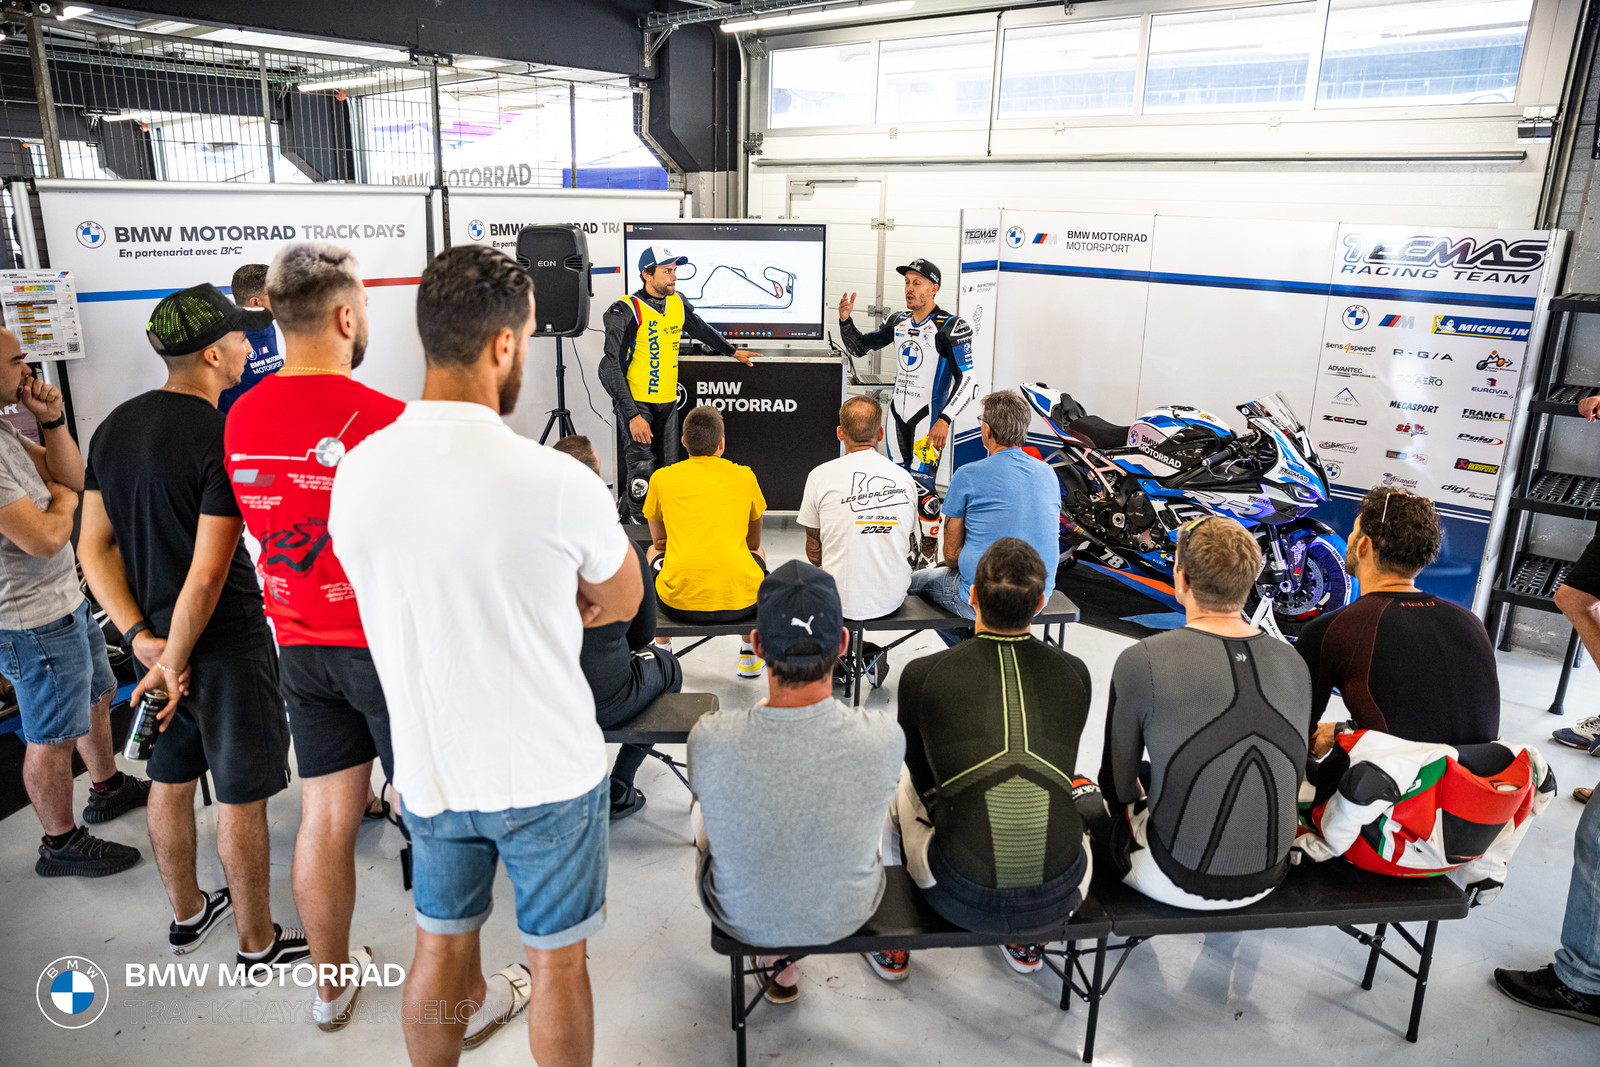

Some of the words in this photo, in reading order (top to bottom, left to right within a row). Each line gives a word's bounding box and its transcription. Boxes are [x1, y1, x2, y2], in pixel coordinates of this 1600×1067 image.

[443, 163, 532, 187] OTORRAD
[114, 226, 172, 243] BMW
[180, 225, 296, 242] MOTORRAD
[301, 224, 360, 240] TRACK
[363, 224, 406, 239] DAYS
[1067, 230, 1091, 240] BMW
[1092, 231, 1148, 243] MOTORRAD
[119, 249, 133, 258] En
[135, 247, 194, 260] partenariat
[195, 249, 218, 257] avec
[220, 246, 243, 255] BMC
[1066, 241, 1131, 253] MOTORSPORT
[1340, 264, 1439, 279] RACING
[1453, 270, 1531, 285] TEAM
[1458, 323, 1530, 336] MICHELIN
[648, 320, 660, 395] TRACKDAYS
[1327, 364, 1363, 374] ADVANTEC
[696, 381, 742, 395] BMW
[1471, 386, 1509, 395] EUROVIA
[696, 398, 798, 412] MOTORRAD
[1389, 400, 1439, 414] MECASPORT
[1463, 408, 1506, 420] FRANCE
[1141, 434, 1159, 449] BMW
[1457, 433, 1494, 444] Puig
[1138, 443, 1182, 468] MOTORRAD
[841, 495, 857, 504] LES
[861, 525, 893, 535] 2022
[1100, 547, 1125, 569] 78
